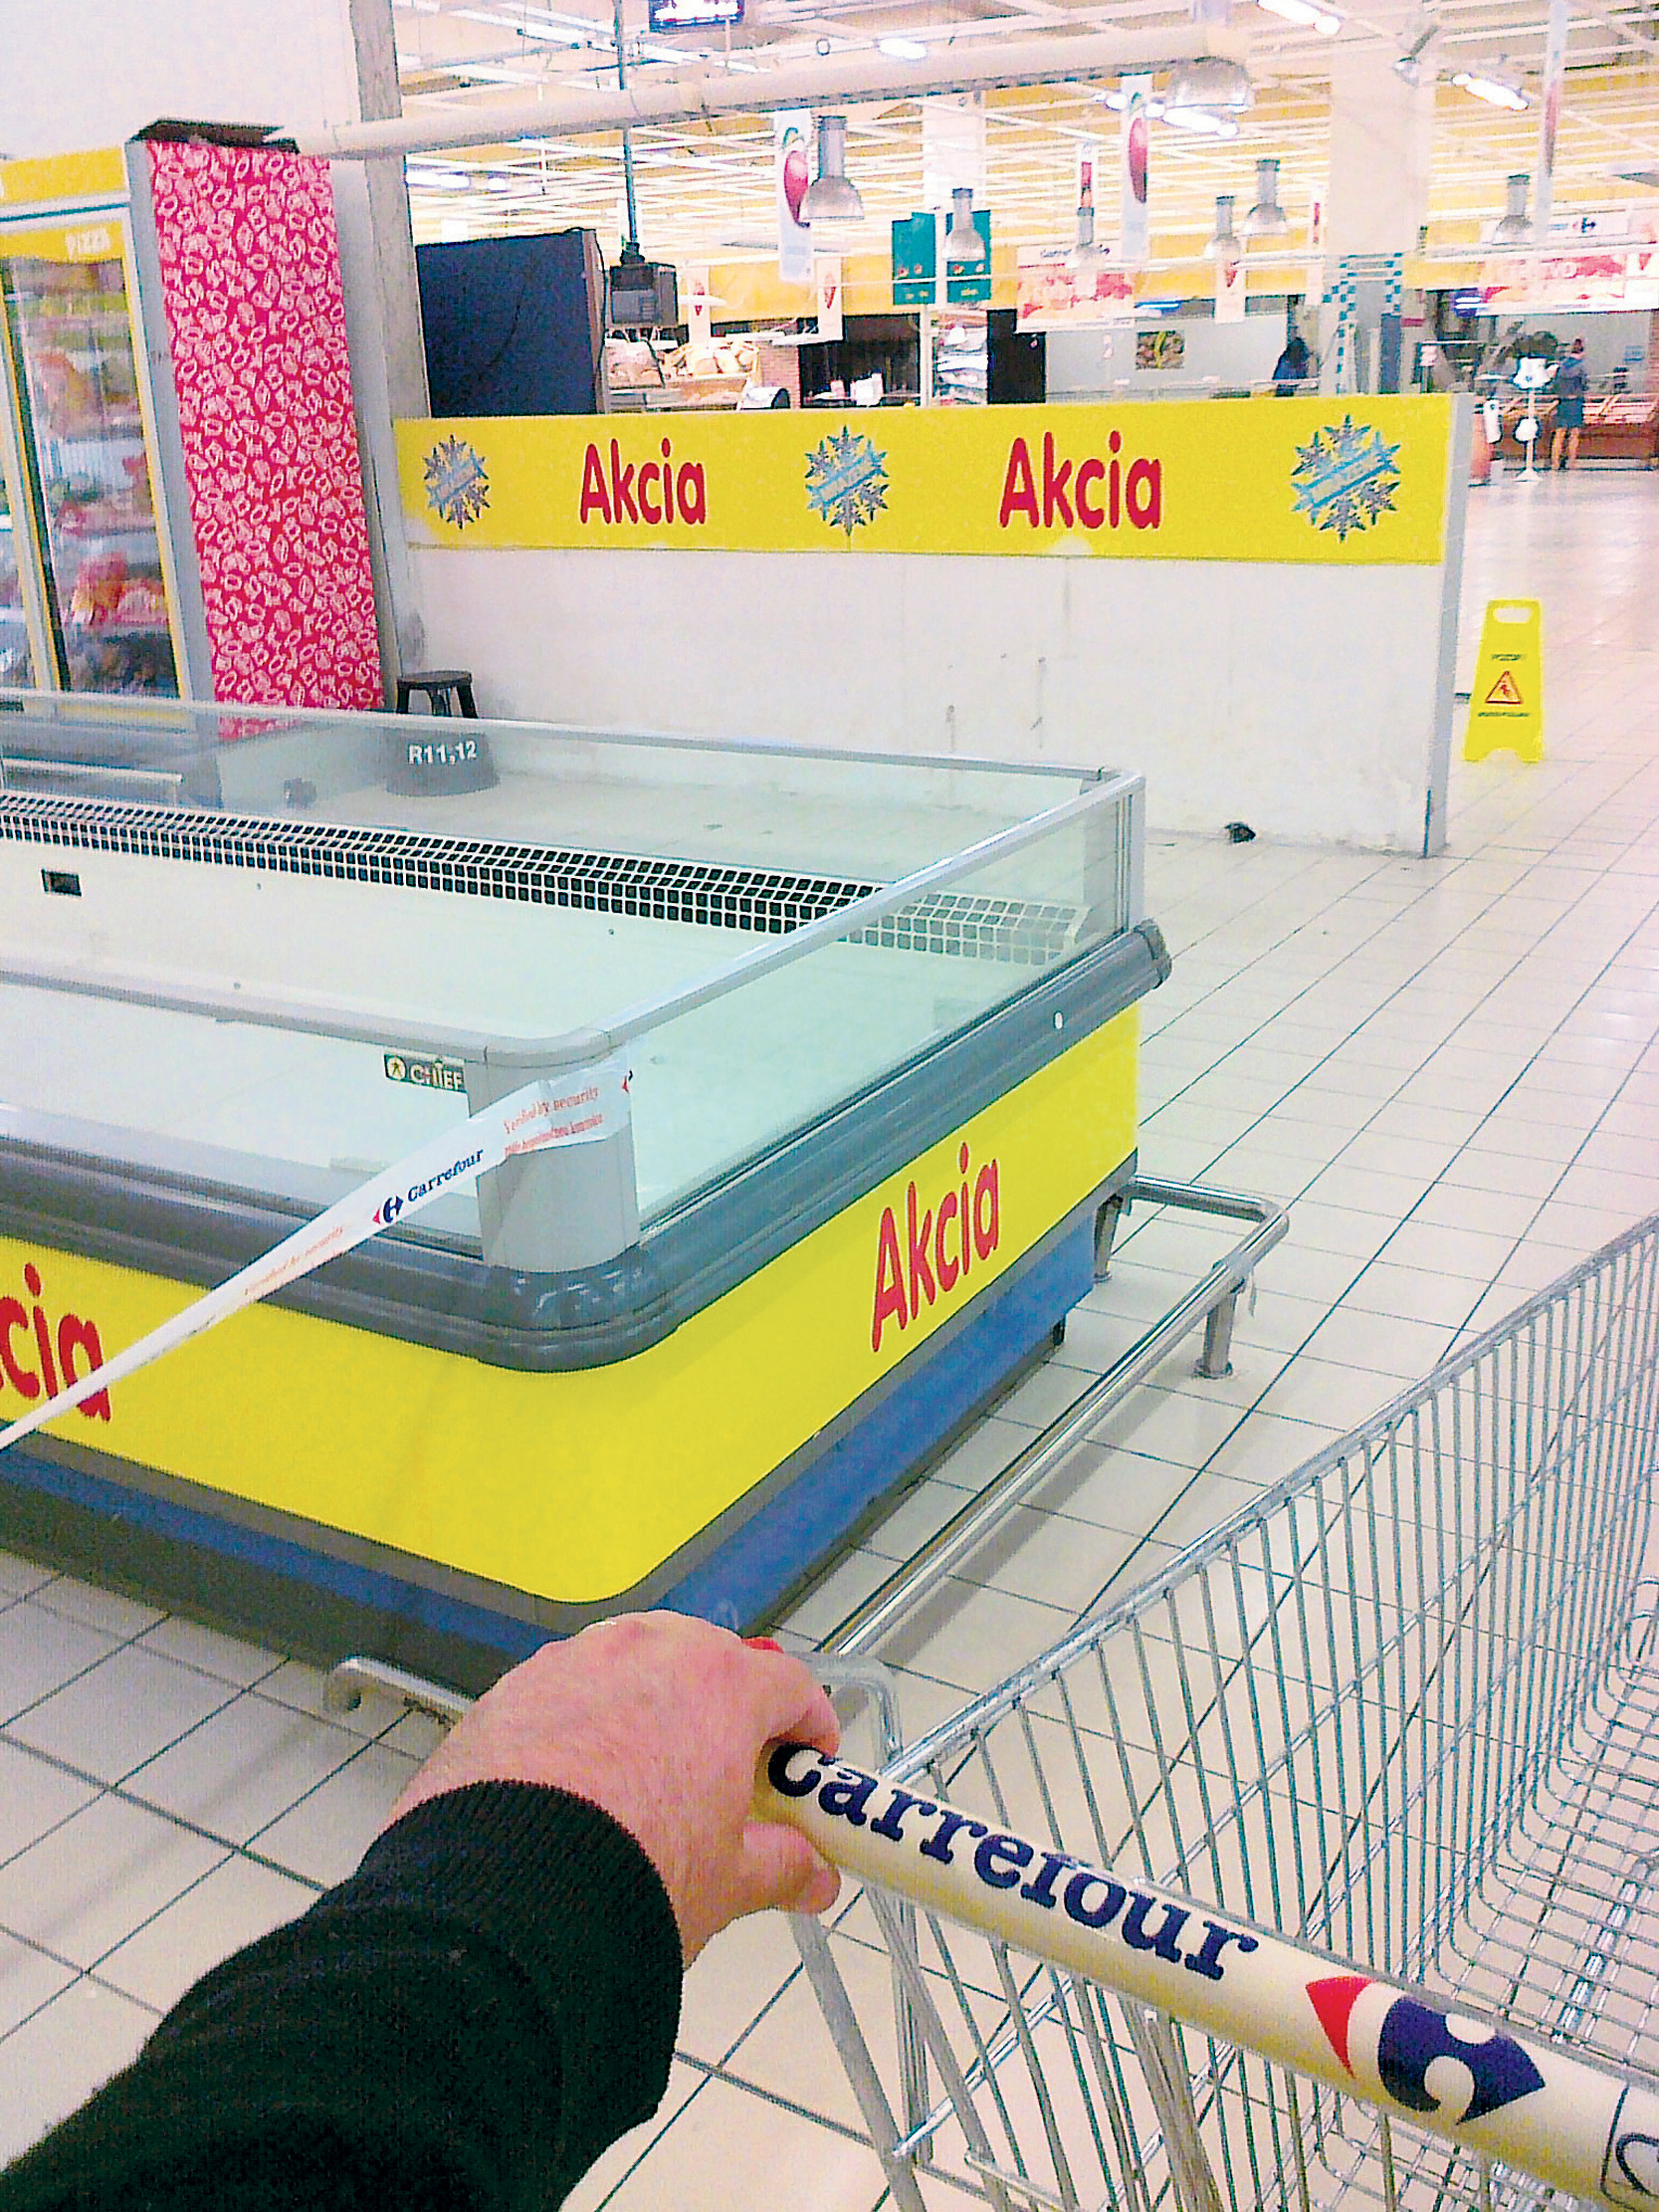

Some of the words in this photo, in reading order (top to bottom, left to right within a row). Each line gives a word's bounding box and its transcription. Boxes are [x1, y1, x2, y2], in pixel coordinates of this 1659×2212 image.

[580, 438, 707, 525] Akcia
[999, 430, 1162, 530] Akcia
[407, 1149, 484, 1202] Carrefour
[872, 1141, 999, 1353] Akcia
[0, 1262, 111, 1423] cia
